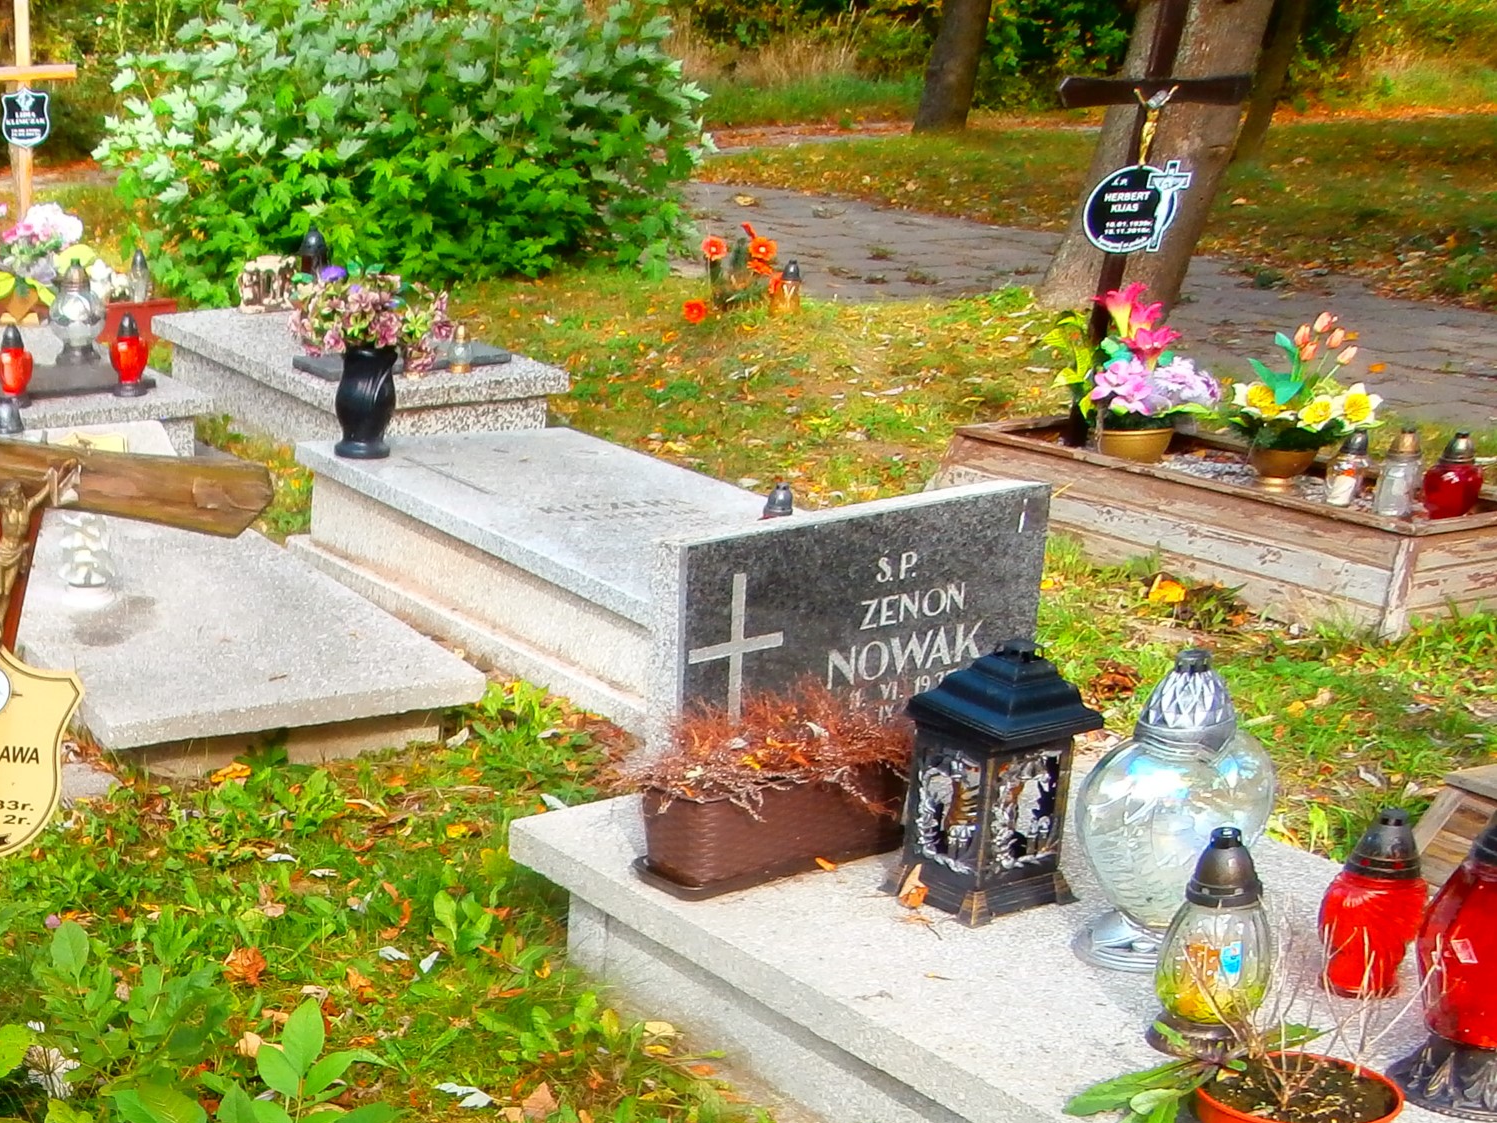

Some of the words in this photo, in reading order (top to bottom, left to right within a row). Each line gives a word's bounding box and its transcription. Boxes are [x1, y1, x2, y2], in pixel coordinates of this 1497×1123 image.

[1103, 191, 1152, 203] HERBERT
[859, 582, 966, 631] ZENON
[826, 619, 984, 691] NOWAK
